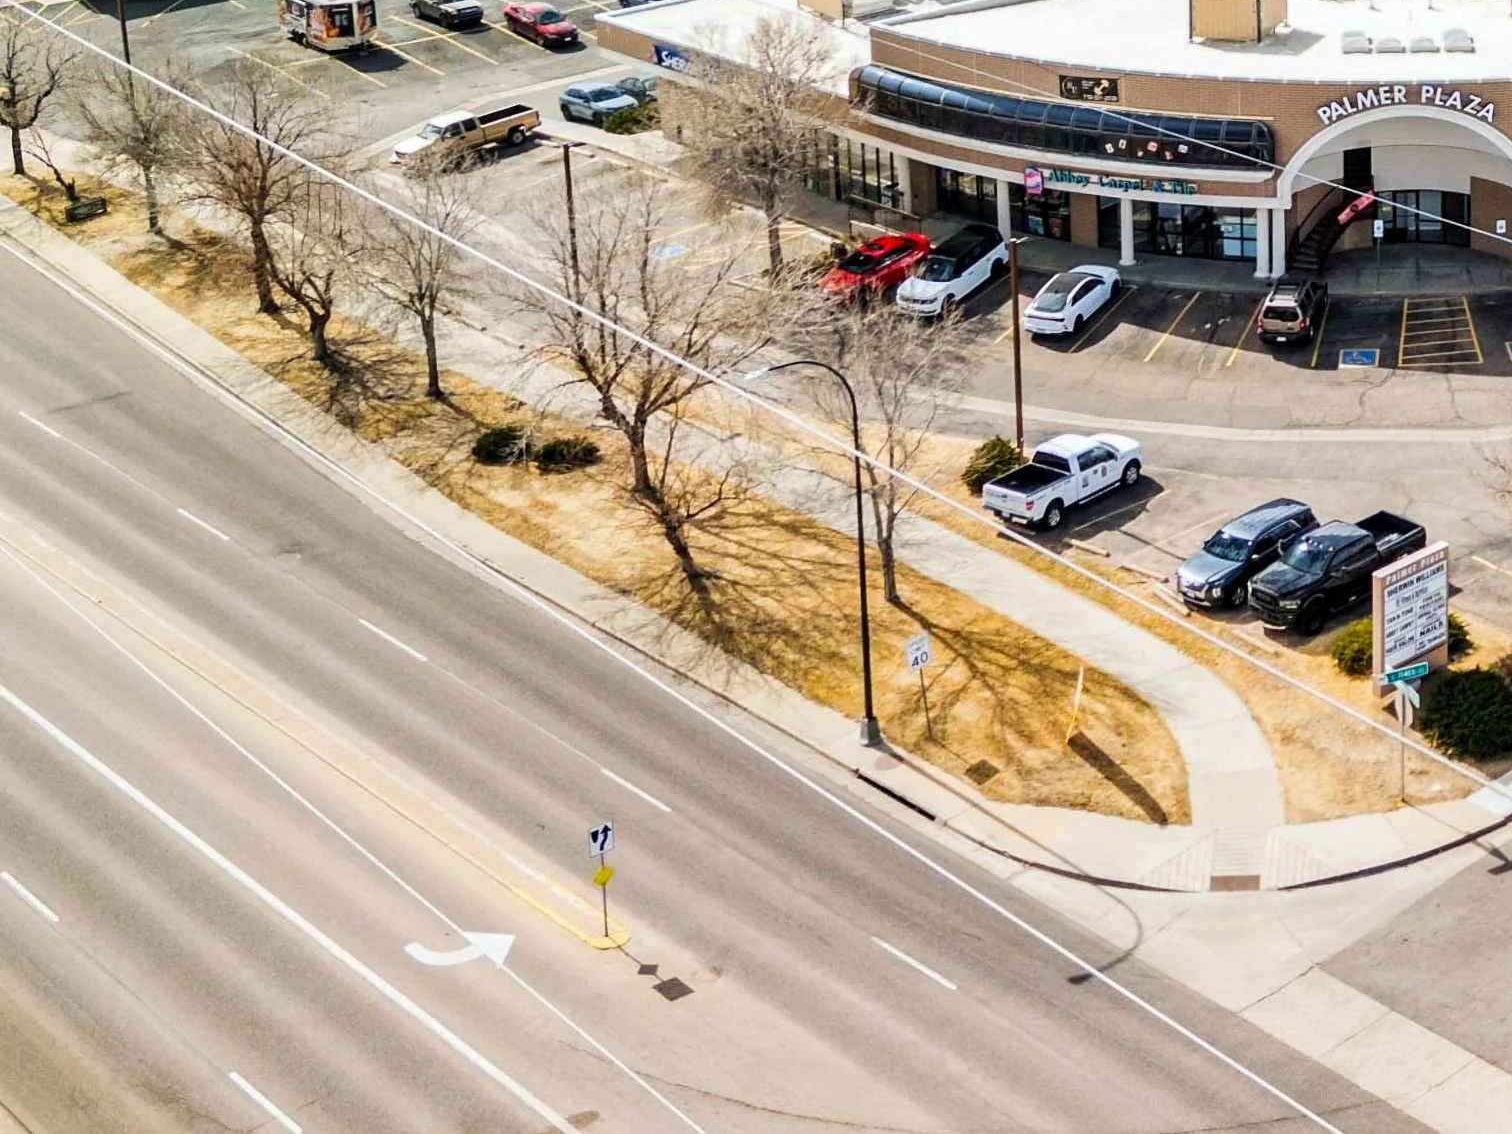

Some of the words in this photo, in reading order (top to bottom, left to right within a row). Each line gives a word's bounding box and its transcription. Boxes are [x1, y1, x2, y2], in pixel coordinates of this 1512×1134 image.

[1317, 85, 1408, 125] PALMER
[1420, 85, 1495, 123] PLAZA
[1048, 168, 1090, 188] Abbey
[1099, 174, 1145, 193] Carpet
[1152, 178, 1164, 193] &
[1170, 178, 1198, 195] Tile
[911, 651, 928, 667] 40
